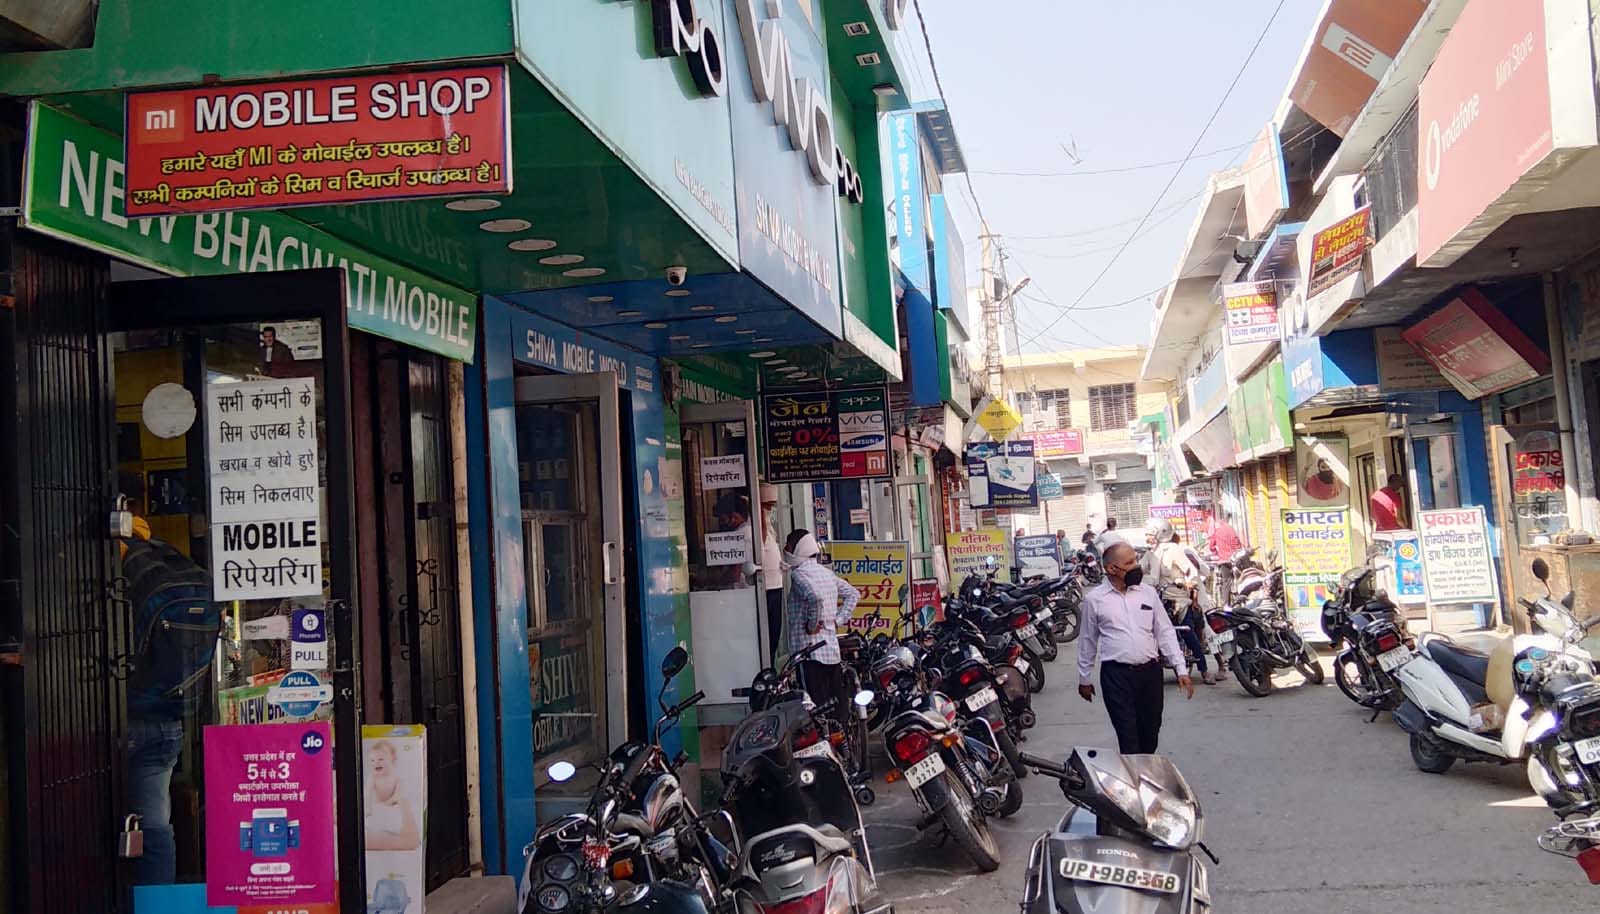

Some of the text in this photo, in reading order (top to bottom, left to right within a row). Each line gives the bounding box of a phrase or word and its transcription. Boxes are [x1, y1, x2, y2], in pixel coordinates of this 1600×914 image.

[195, 76, 491, 132] MOBILE SHOP
[161, 151, 206, 174] हमारे
[211, 148, 246, 170] यहाँ
[250, 145, 272, 166] MI
[278, 144, 298, 164] के
[835, 142, 864, 204] ppo
[175, 177, 258, 202] कम्पनियों
[261, 175, 280, 196] के
[285, 173, 323, 195] सिम
[327, 176, 342, 191] व
[383, 277, 470, 347] MOBILE
[527, 329, 557, 366] SHIVA
[562, 341, 594, 373] MOBILE
[217, 388, 243, 413] सभी
[299, 383, 313, 407] के
[219, 420, 243, 443] सिम
[796, 427, 839, 445] 0%
[218, 457, 249, 472] खराब
[254, 456, 263, 470] व
[705, 471, 741, 484] रिपेयरिंग
[220, 485, 245, 506] सिम
[1285, 511, 1343, 525] भारत
[1422, 511, 1477, 530] प्रकाश
[223, 520, 317, 551] MOBILE
[221, 556, 318, 589] रिपेयरिंग
[295, 650, 325, 662] PULL
[287, 676, 312, 686] PULL
[240, 696, 264, 725] NEW
[302, 734, 323, 749] Jio
[247, 763, 259, 780] 5
[278, 762, 290, 779] 3
[1096, 848, 1140, 860] HONDA
[1063, 861, 1088, 877] UP
